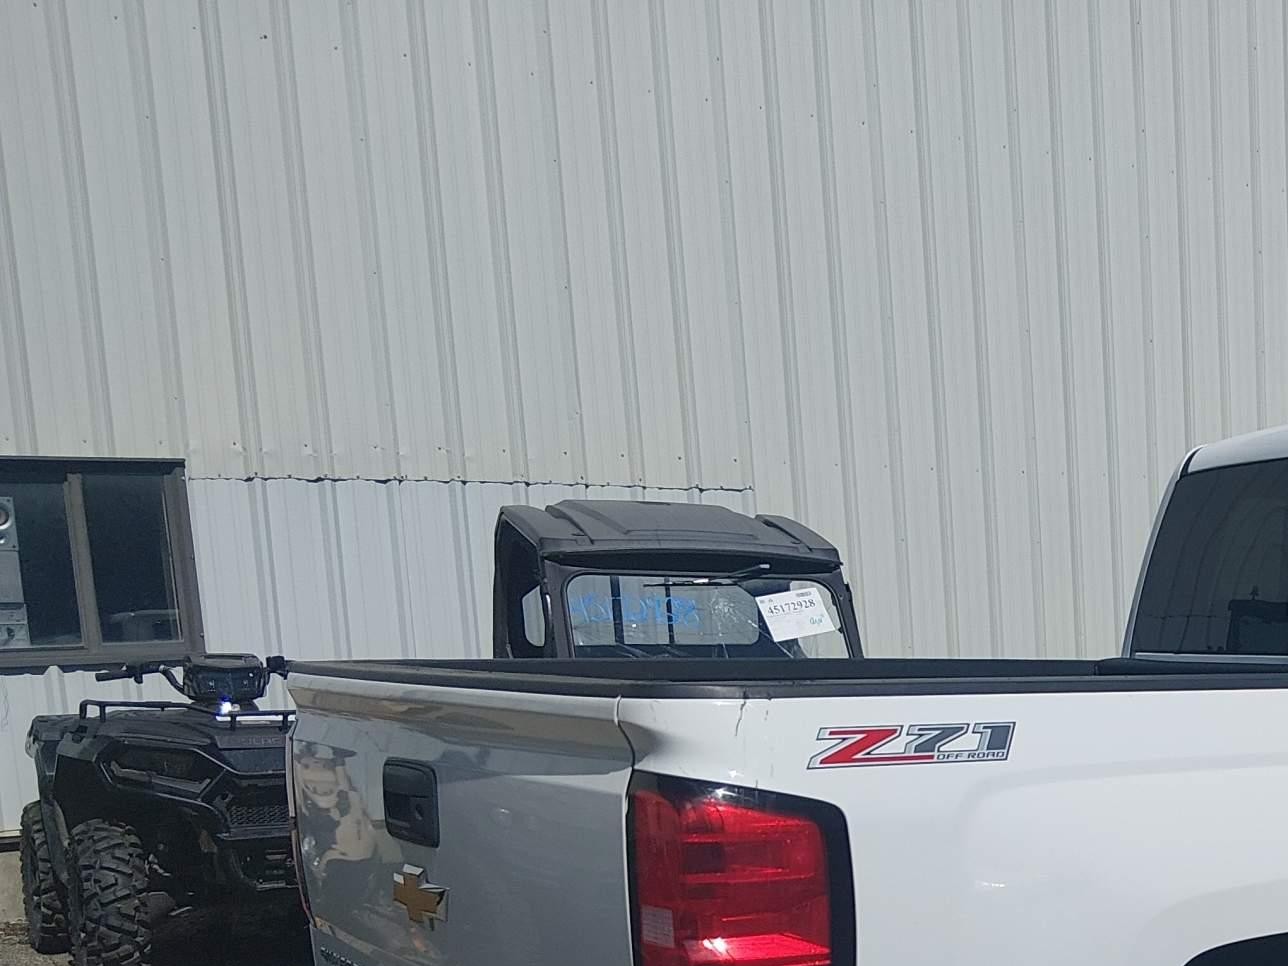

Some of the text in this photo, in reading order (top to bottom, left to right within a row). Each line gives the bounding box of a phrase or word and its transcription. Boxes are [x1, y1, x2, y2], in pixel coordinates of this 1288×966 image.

[767, 598, 816, 615] 45172928
[807, 721, 1016, 770] Z71
[936, 751, 1005, 761] OFF ROAD
